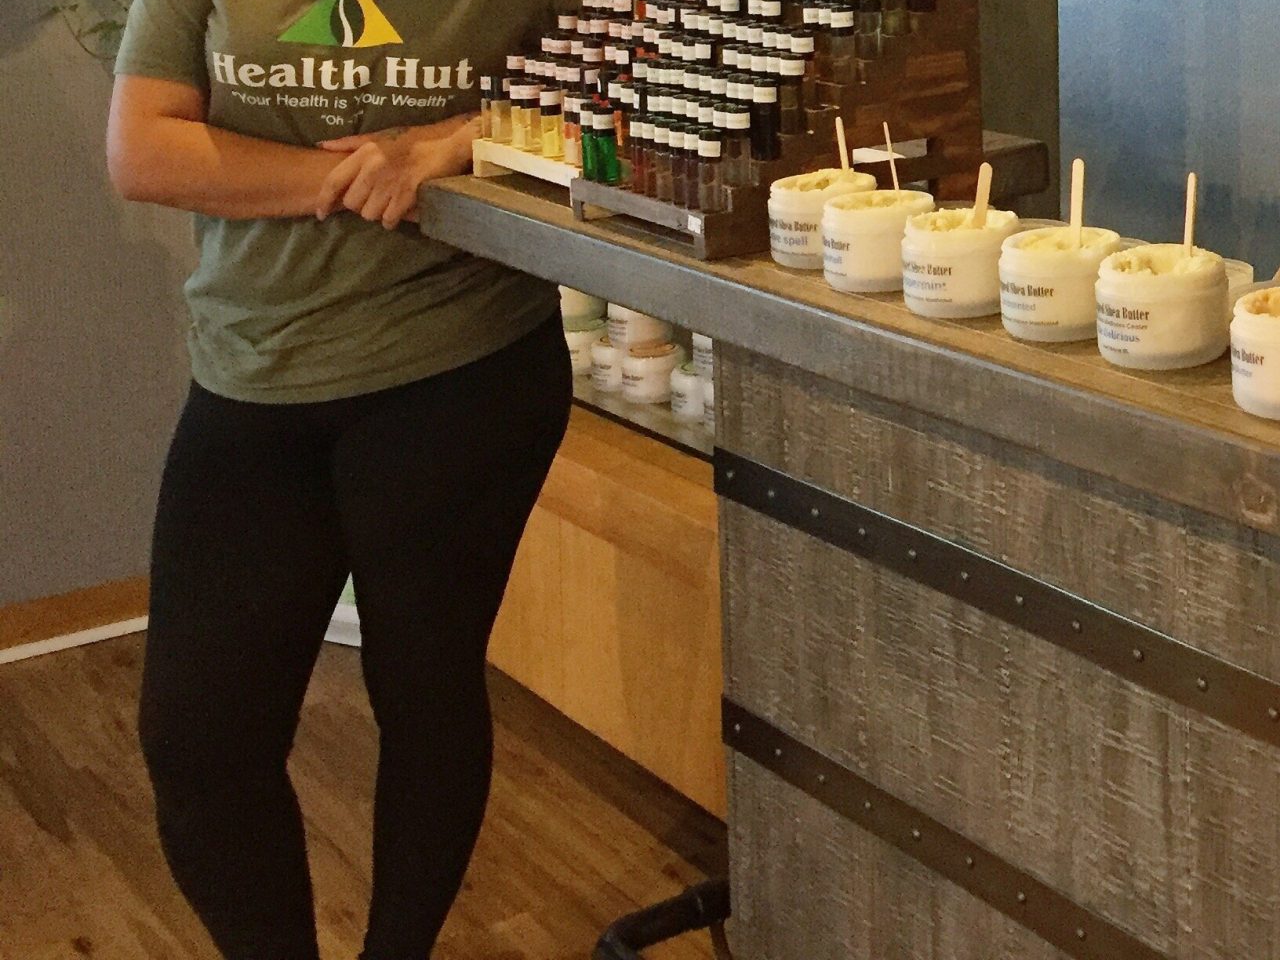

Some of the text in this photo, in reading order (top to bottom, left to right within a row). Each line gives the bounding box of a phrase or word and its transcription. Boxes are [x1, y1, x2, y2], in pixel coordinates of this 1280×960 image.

[212, 51, 474, 90] Health Hut
[276, 93, 329, 107] Health
[334, 96, 348, 109] is
[1027, 284, 1054, 297] Butter
[1122, 306, 1149, 320] Butter
